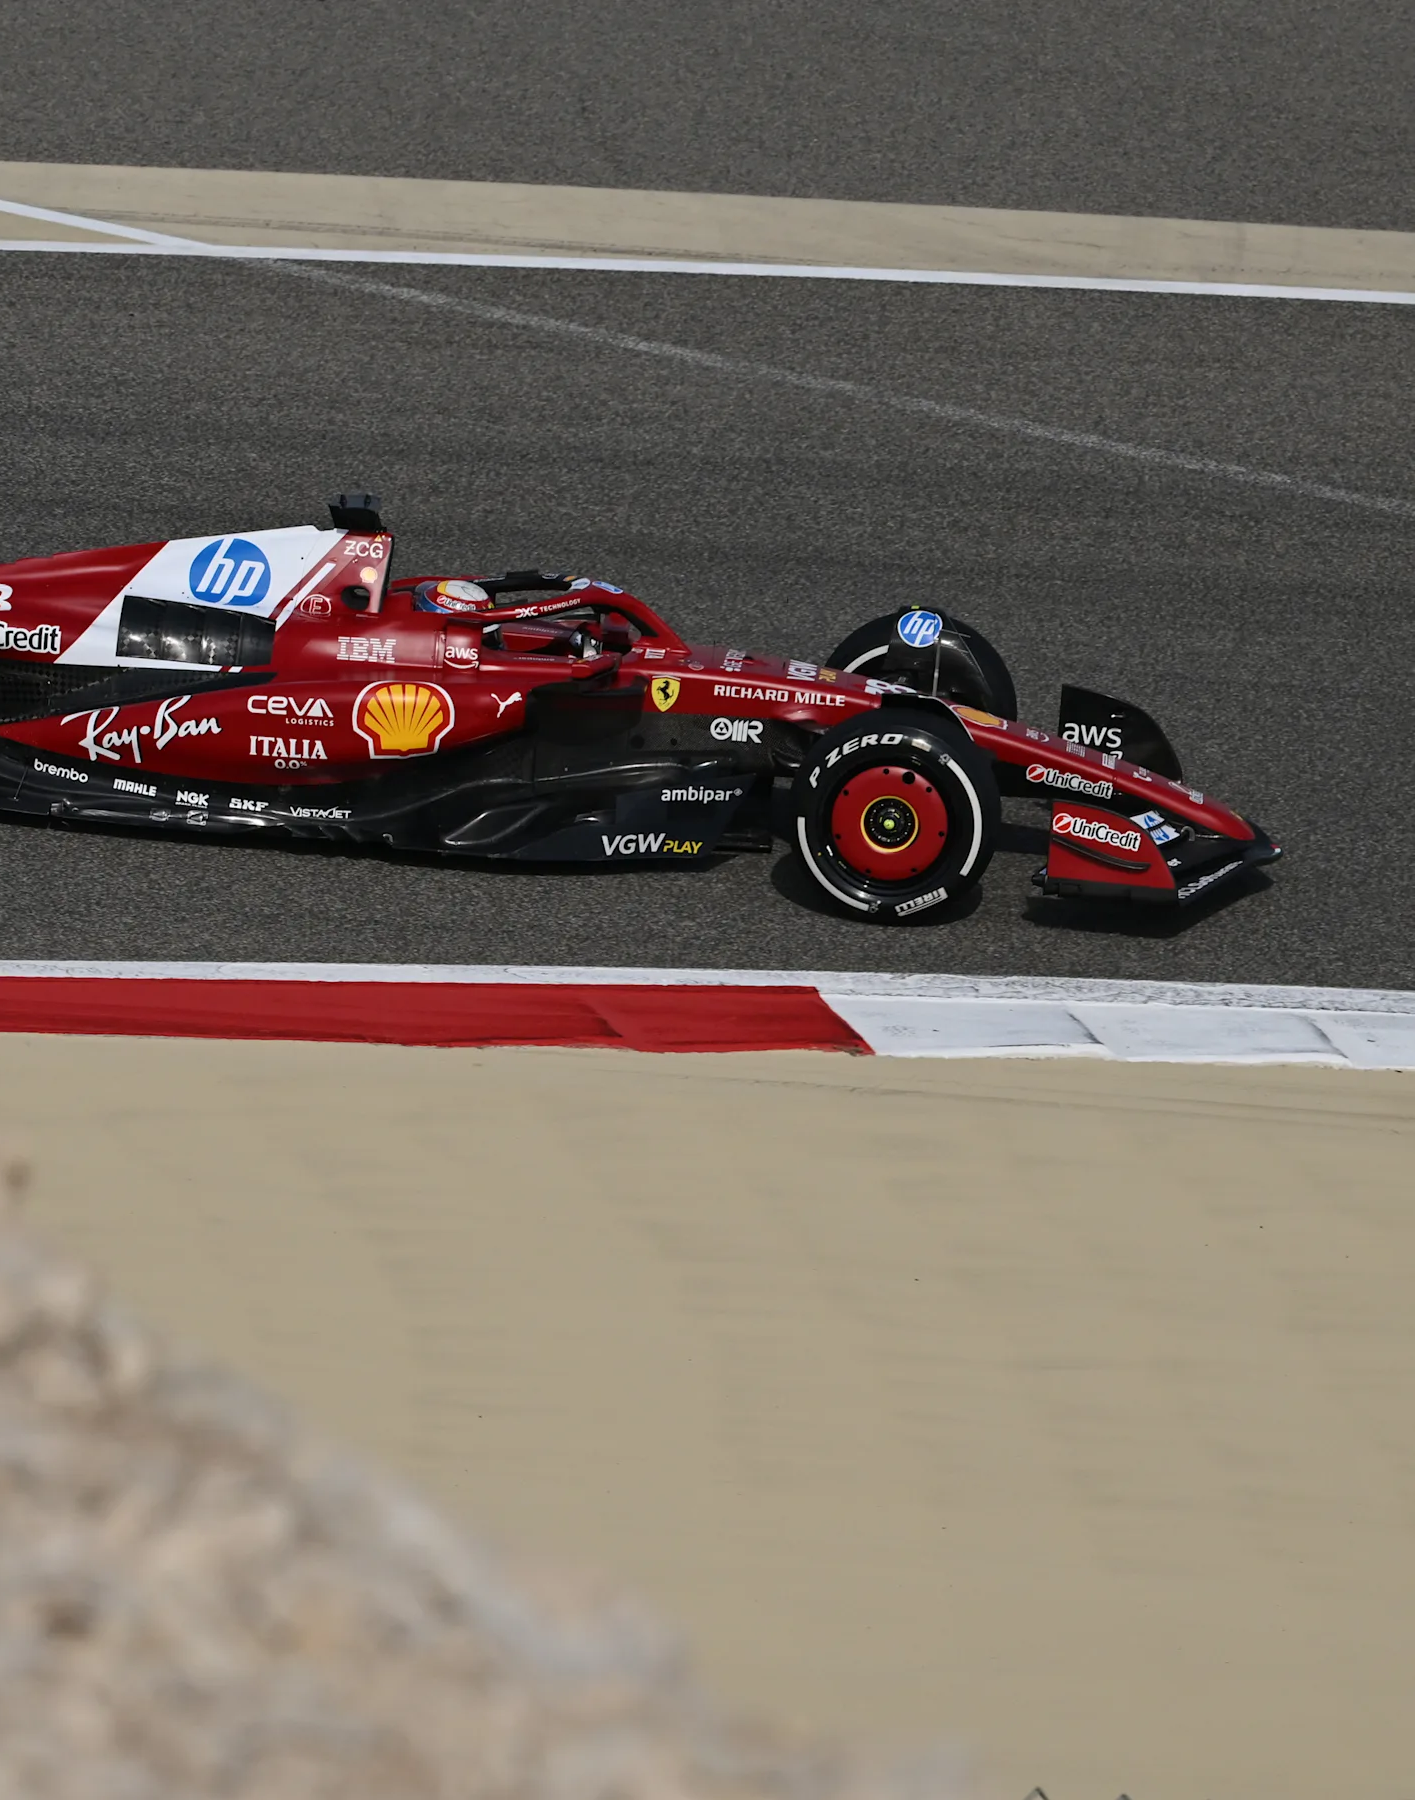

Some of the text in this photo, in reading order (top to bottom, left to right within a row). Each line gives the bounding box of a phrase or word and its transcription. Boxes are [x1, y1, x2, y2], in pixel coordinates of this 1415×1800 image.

[193, 538, 267, 606] hp
[539, 597, 582, 613] TECHNOLOGY
[903, 611, 939, 646] hp
[336, 636, 397, 663] IBM
[444, 645, 479, 661] aws
[713, 684, 846, 707] RICHARD MILLE
[285, 717, 334, 727] LOGISTICS
[249, 735, 329, 760] ITALIA
[1062, 722, 1123, 749] aws
[33, 758, 89, 783] brembo
[808, 733, 904, 789] P ZERO
[113, 778, 157, 797] MAHLE
[661, 786, 733, 804] ambipar
[1045, 768, 1113, 799] UniCredit
[176, 789, 210, 806] NGK
[229, 798, 269, 812] SKF
[601, 833, 703, 856] VGW PLAY
[1071, 816, 1141, 851] UniCredit
[894, 886, 949, 917] PIRELLI
